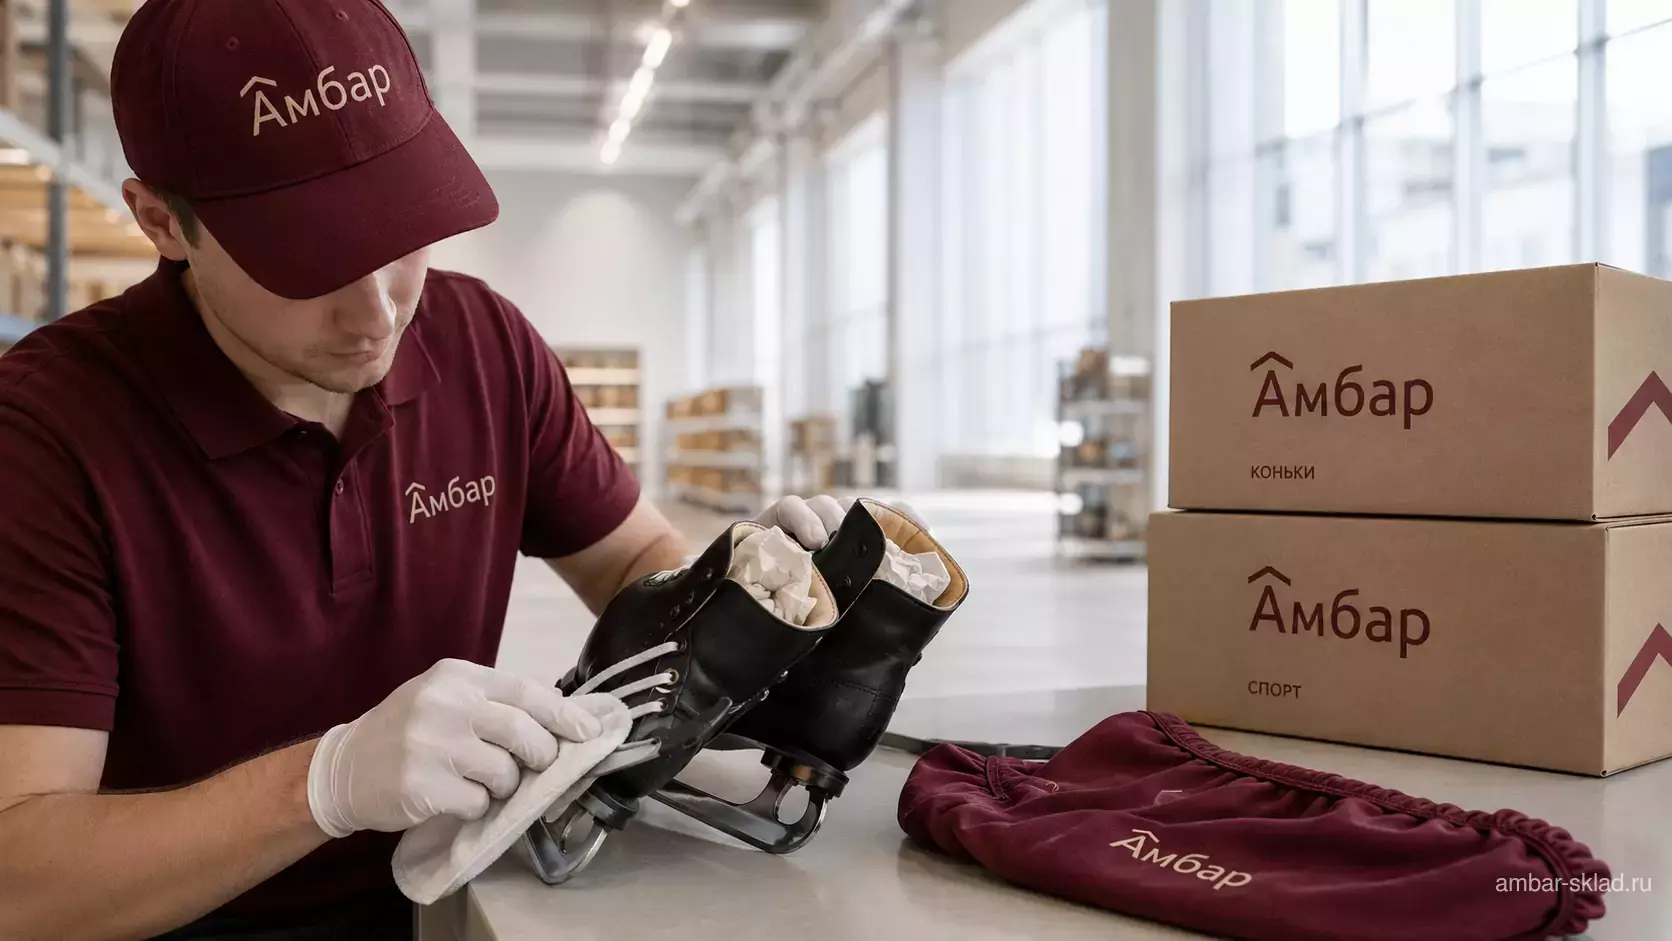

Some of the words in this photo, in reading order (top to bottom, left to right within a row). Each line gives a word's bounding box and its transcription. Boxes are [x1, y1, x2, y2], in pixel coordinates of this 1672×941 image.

[240, 64, 391, 136] Амбар
[1250, 351, 1434, 430] Амбар
[405, 475, 496, 524] Амбар
[1251, 465, 1315, 480] КОНЬКИ
[1248, 566, 1431, 659] Амбар
[1248, 680, 1302, 699] СПОРТ
[1109, 828, 1252, 890] Амбар
